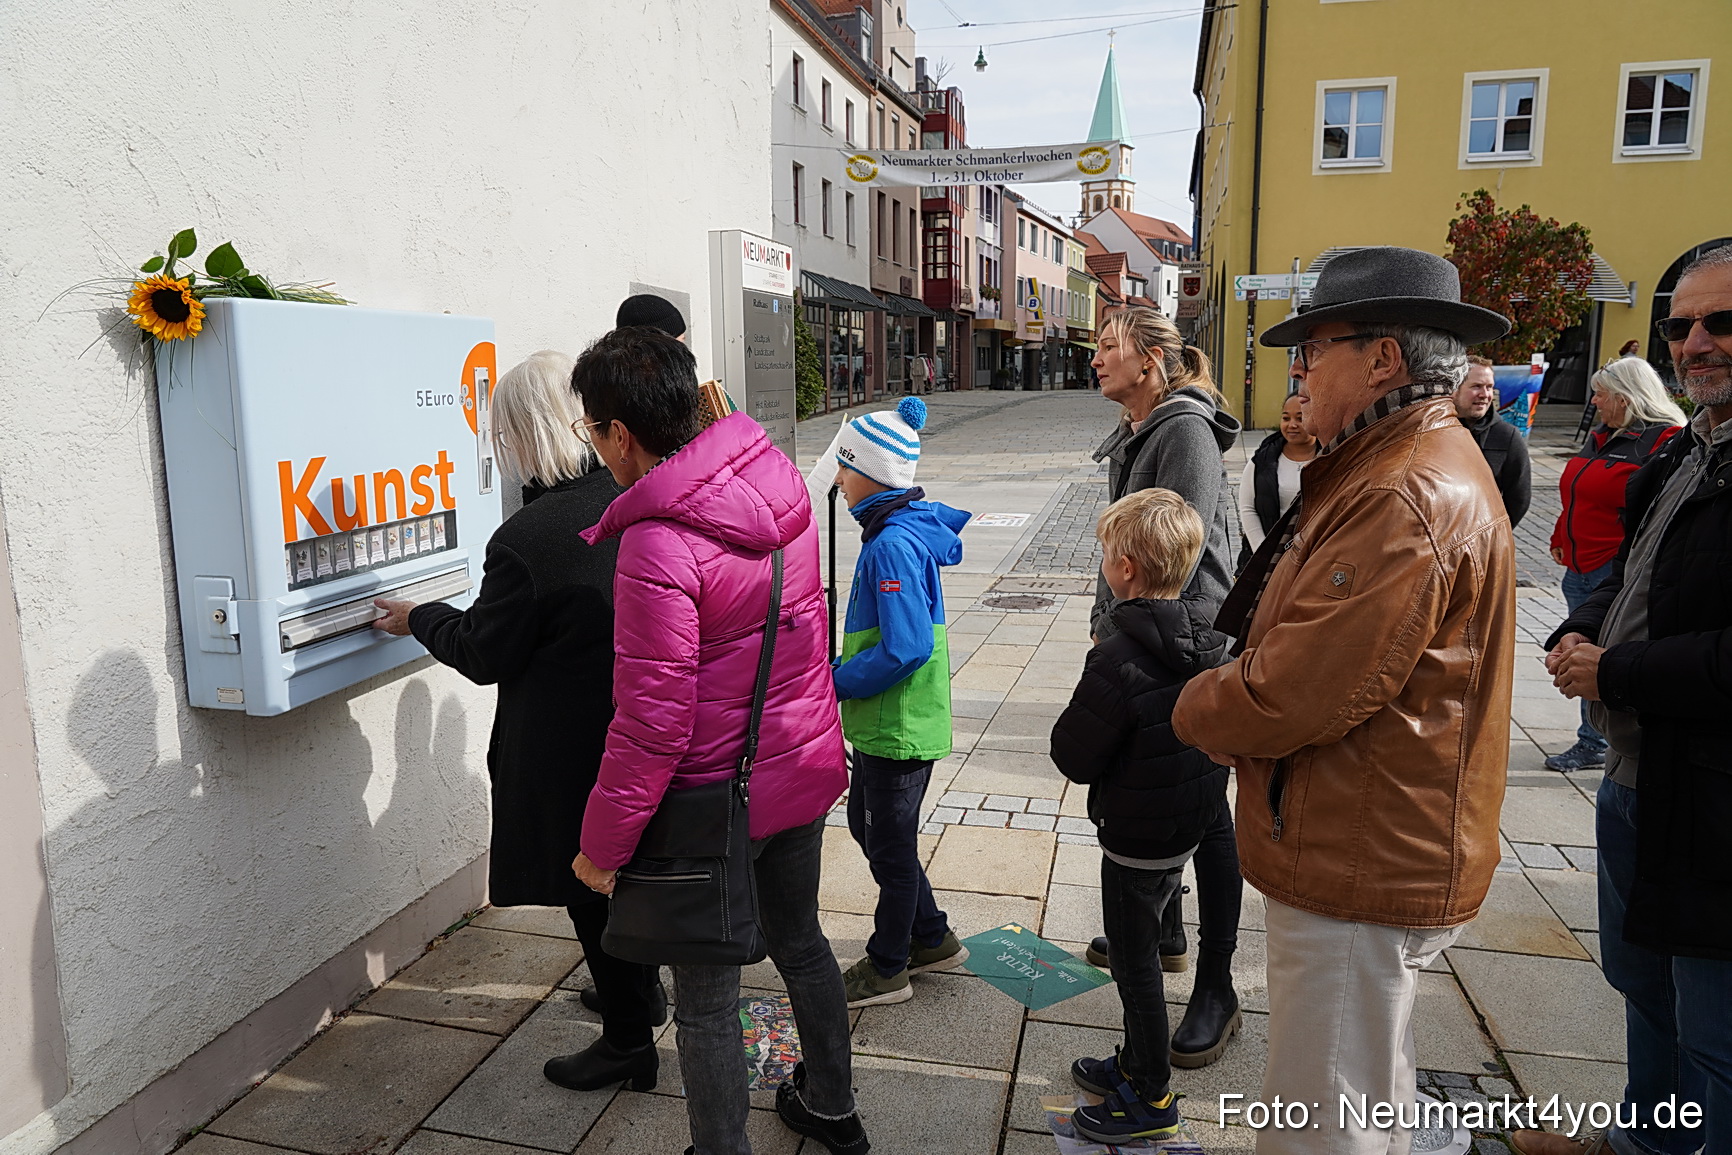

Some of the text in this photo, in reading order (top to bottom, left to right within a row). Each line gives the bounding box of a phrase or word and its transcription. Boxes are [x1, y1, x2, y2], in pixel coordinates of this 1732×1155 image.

[882, 154, 953, 167] Neumarkter
[955, 150, 1073, 166] Schmankerlwochen
[931, 172, 941, 183] 1.
[952, 170, 971, 182] 31.
[974, 170, 1024, 182] Oktober
[744, 240, 784, 268] NEUMARKT
[1028, 298, 1037, 308] B
[278, 450, 456, 542] Kunst
[996, 952, 1044, 980] KULTUR
